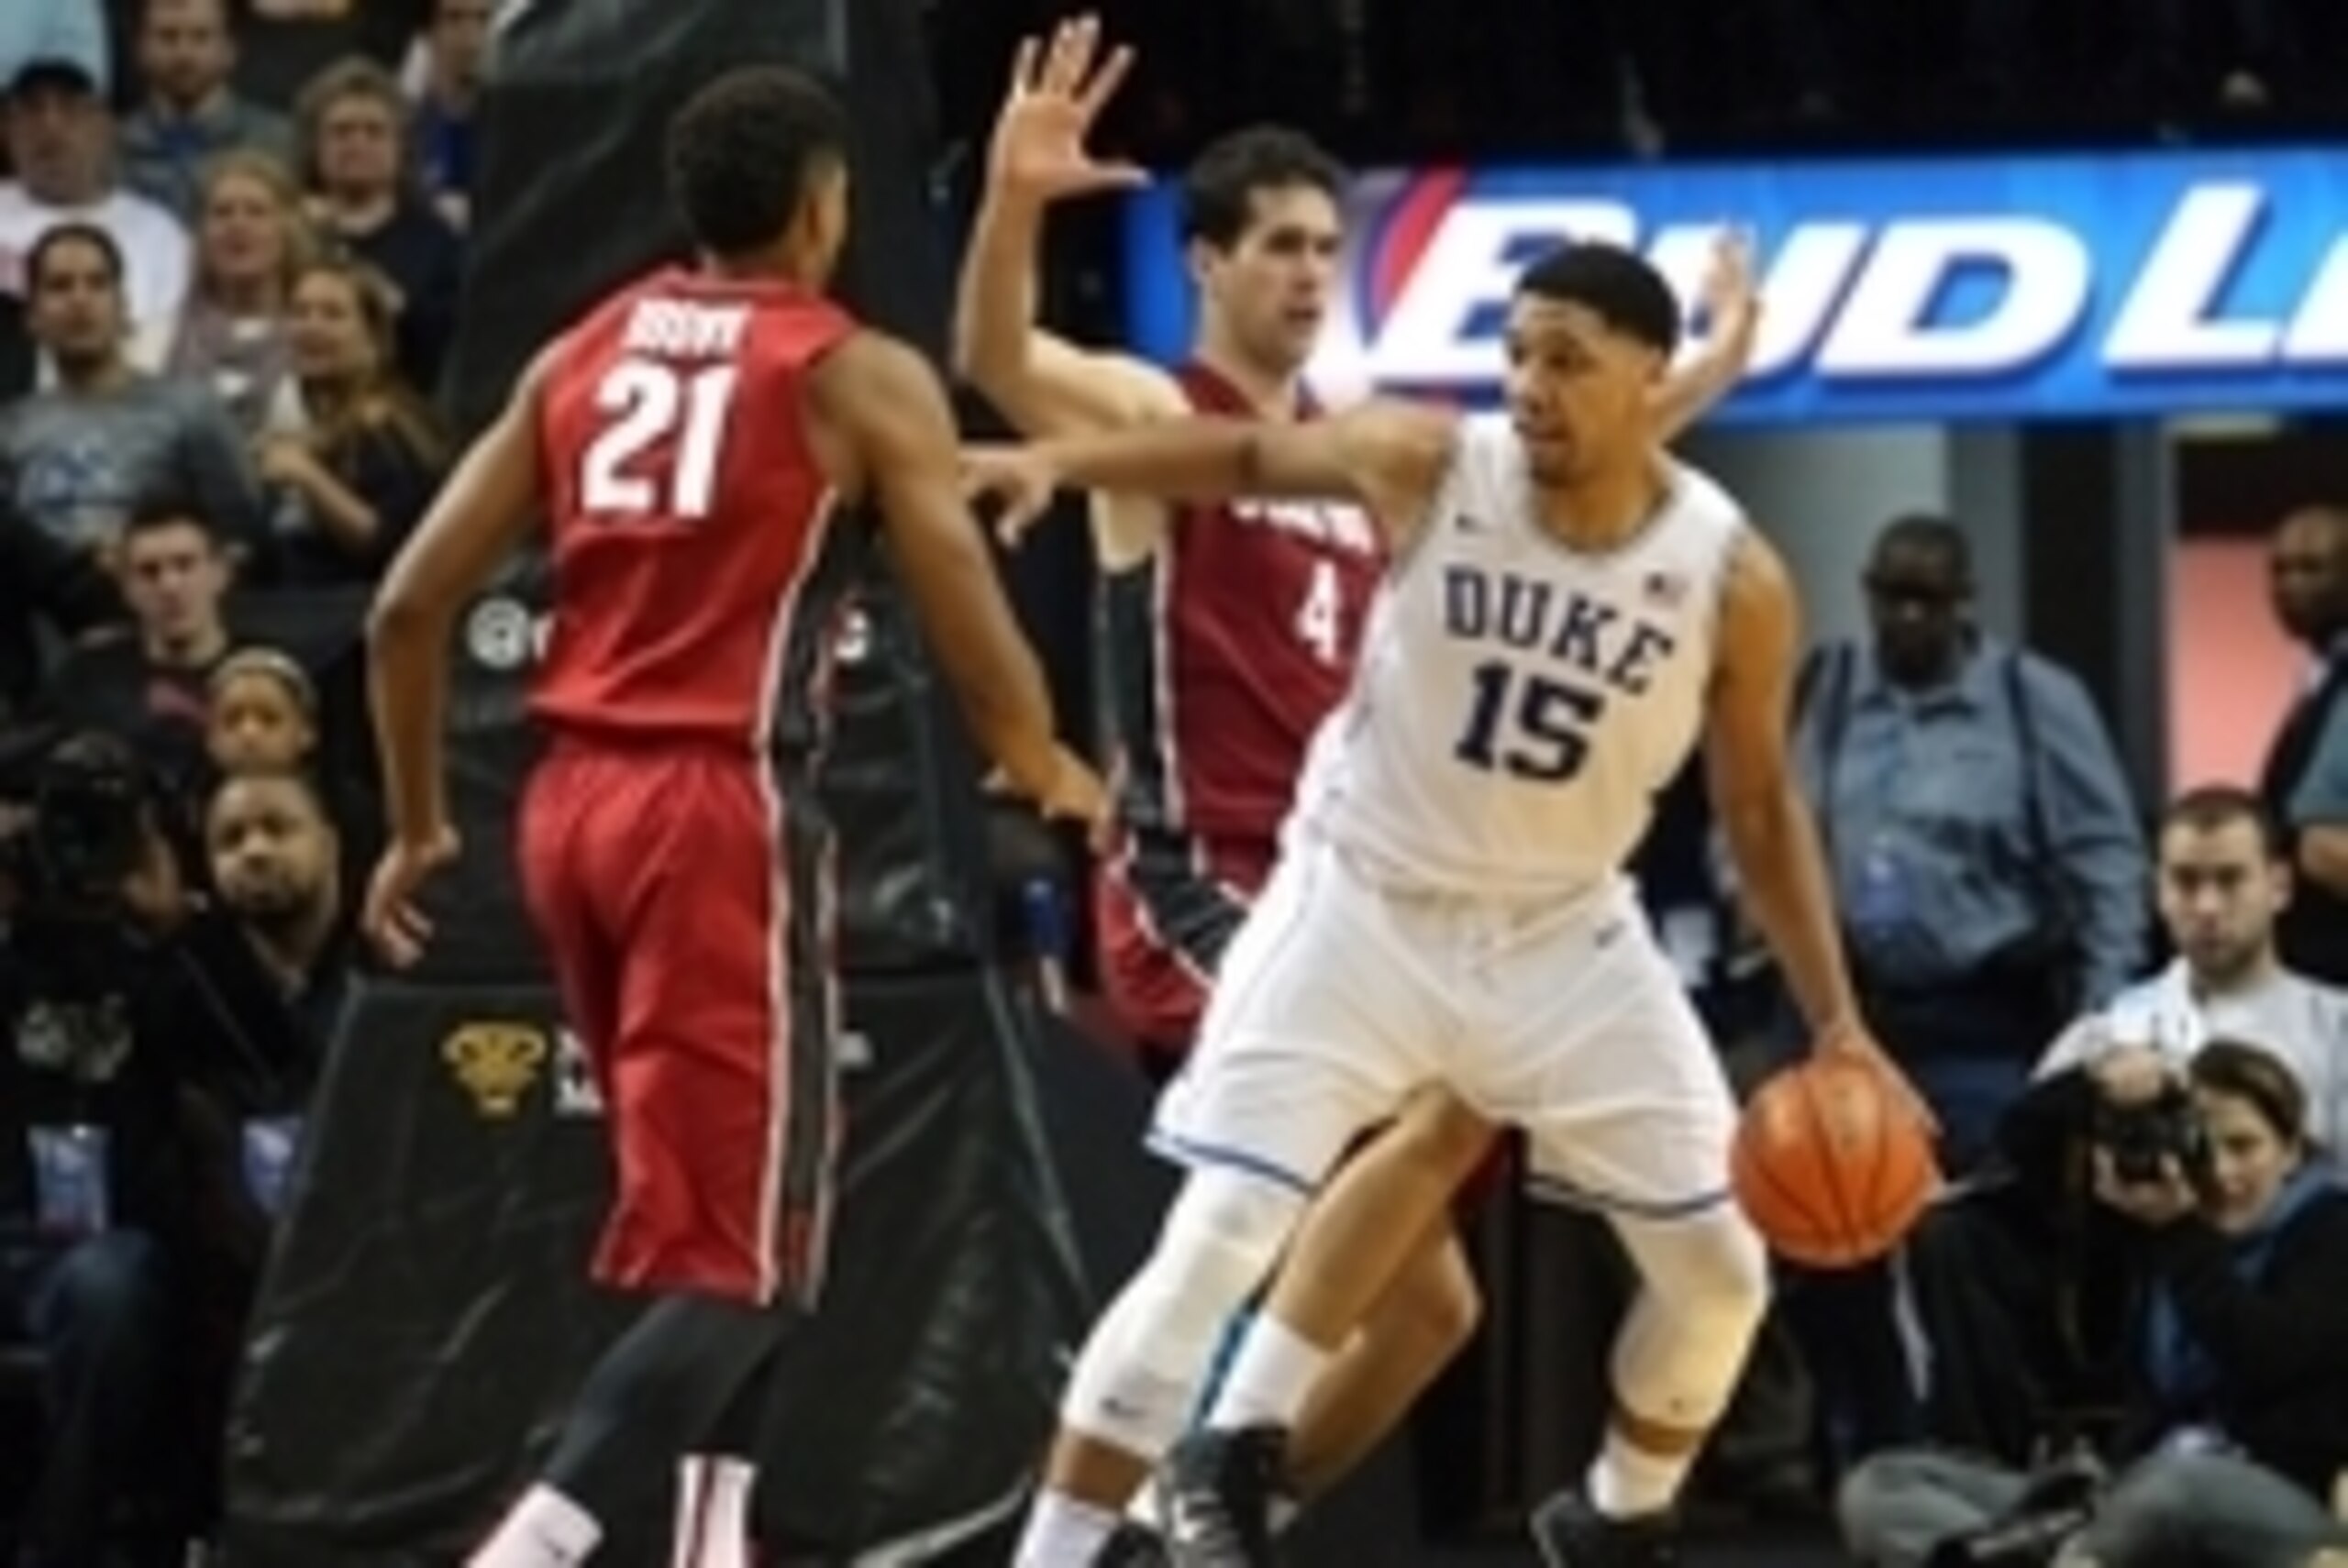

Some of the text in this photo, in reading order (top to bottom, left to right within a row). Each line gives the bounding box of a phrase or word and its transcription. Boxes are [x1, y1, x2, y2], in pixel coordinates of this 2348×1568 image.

[1370, 200, 2093, 374] BUD
[580, 356, 739, 520] 21
[1295, 559, 1339, 668] 4
[1443, 563, 1677, 696] DUKE
[1455, 660, 1605, 787] 15
